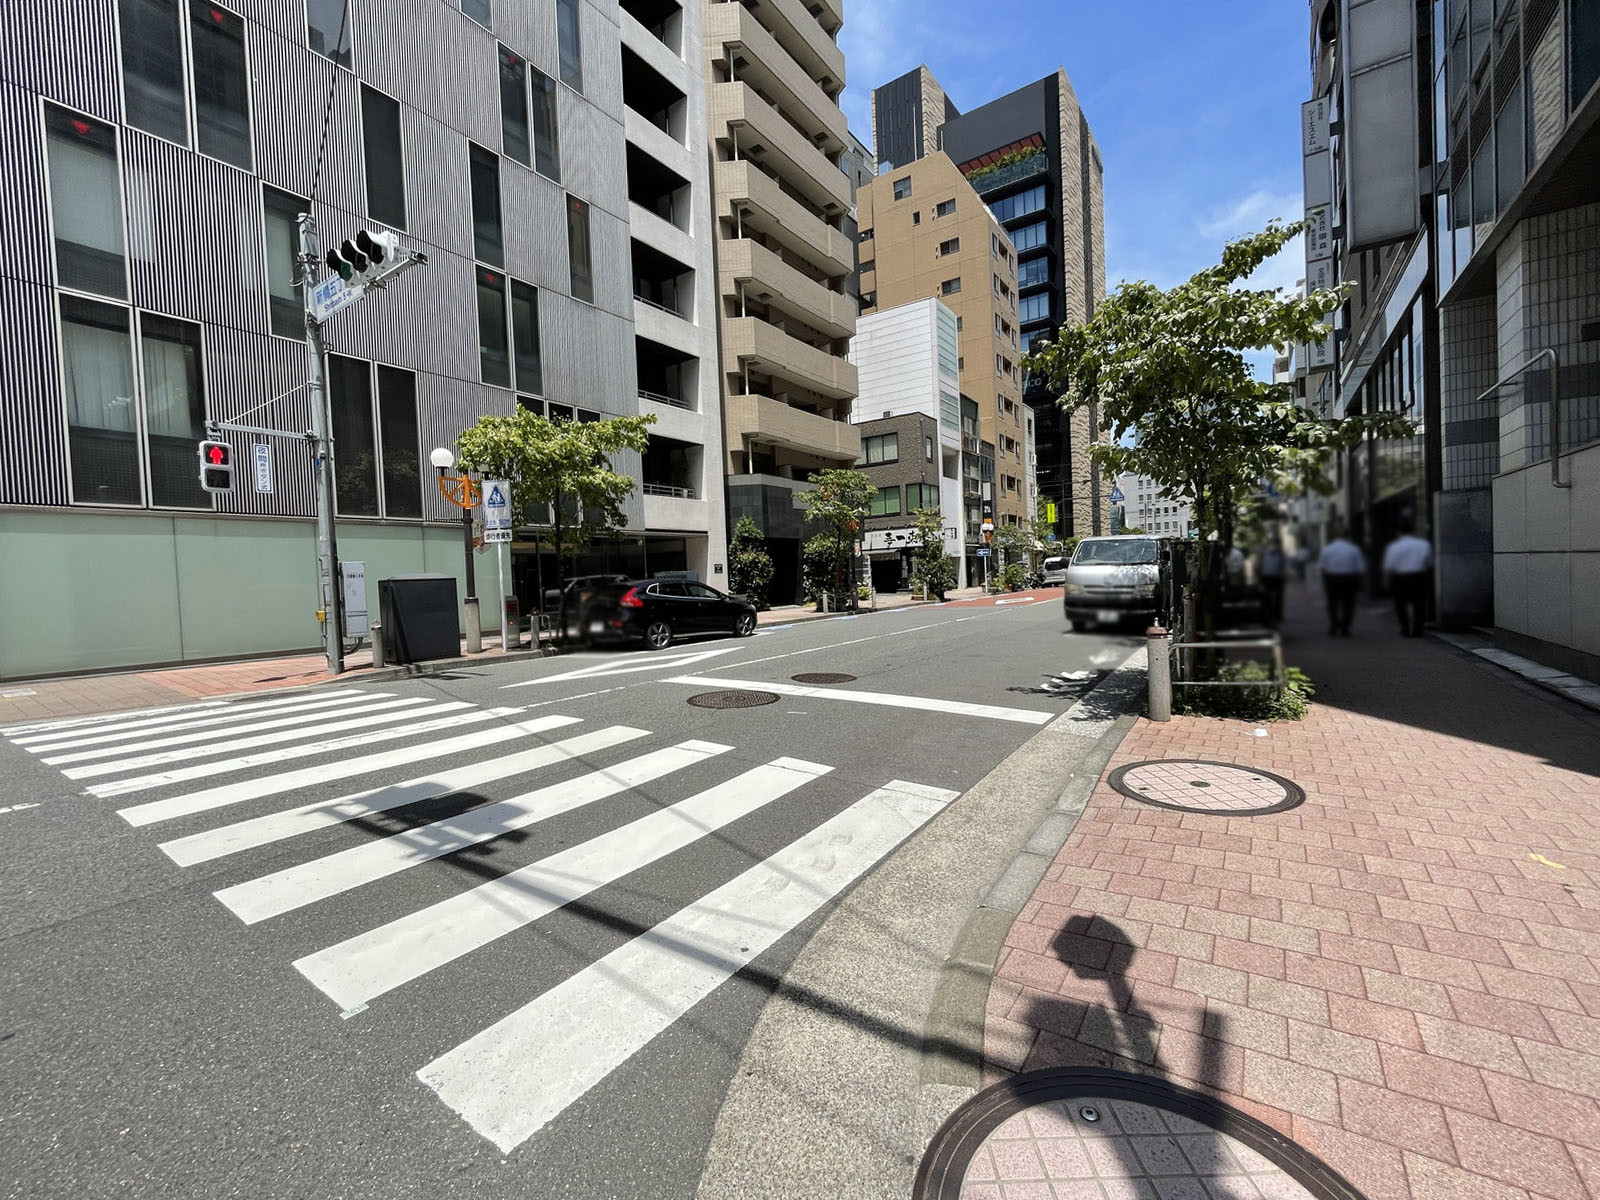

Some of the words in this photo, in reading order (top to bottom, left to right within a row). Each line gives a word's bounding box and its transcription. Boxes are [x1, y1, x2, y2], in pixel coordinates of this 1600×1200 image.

[1308, 109, 1316, 146] シーエスエム
[316, 277, 343, 304] 新橋五丁
[486, 531, 511, 541] 歩行者優先
